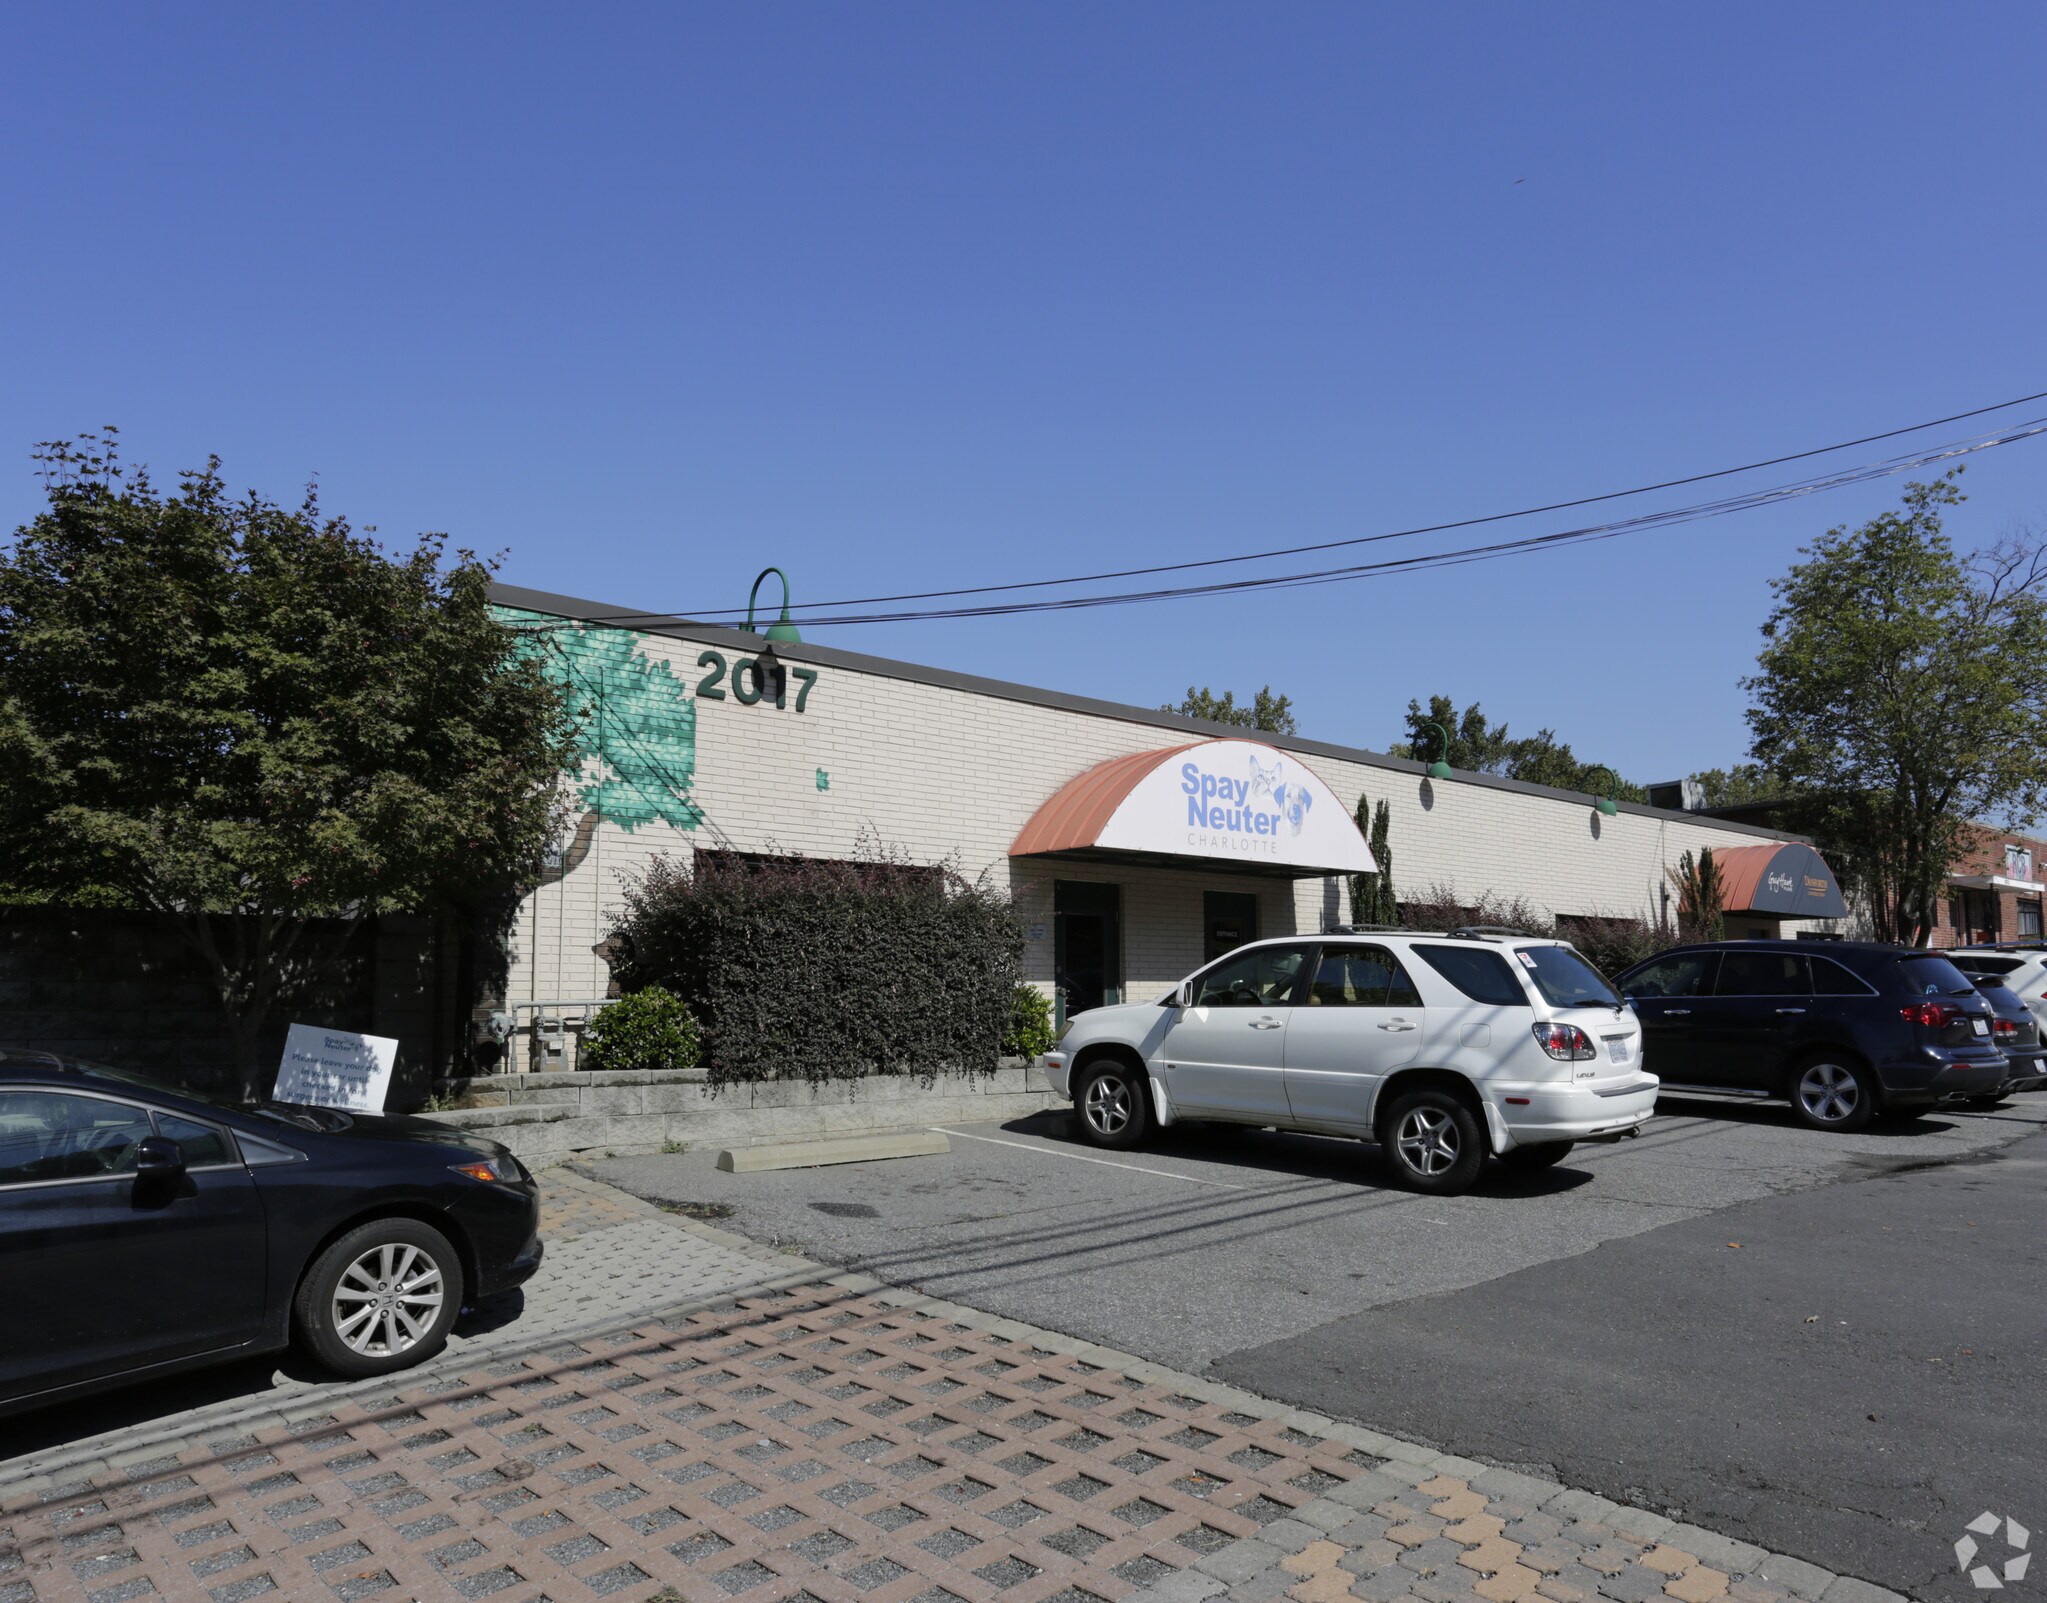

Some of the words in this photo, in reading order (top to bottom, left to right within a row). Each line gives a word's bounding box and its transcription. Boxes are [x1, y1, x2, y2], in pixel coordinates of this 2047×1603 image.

[696, 650, 818, 713] 2017
[1181, 762, 1250, 807] Spay
[1188, 795, 1281, 836] Neuter
[1187, 832, 1277, 854] CHARLOTTE
[324, 1036, 344, 1046] Spay
[324, 1043, 352, 1052] Neuter
[291, 1053, 319, 1064] Please
[320, 1057, 343, 1068] leave
[345, 1062, 364, 1071] your
[366, 1064, 382, 1075] dog
[300, 1066, 311, 1075] in
[311, 1069, 332, 1079] your
[348, 1075, 368, 1084] until
[302, 1081, 336, 1092] checked
